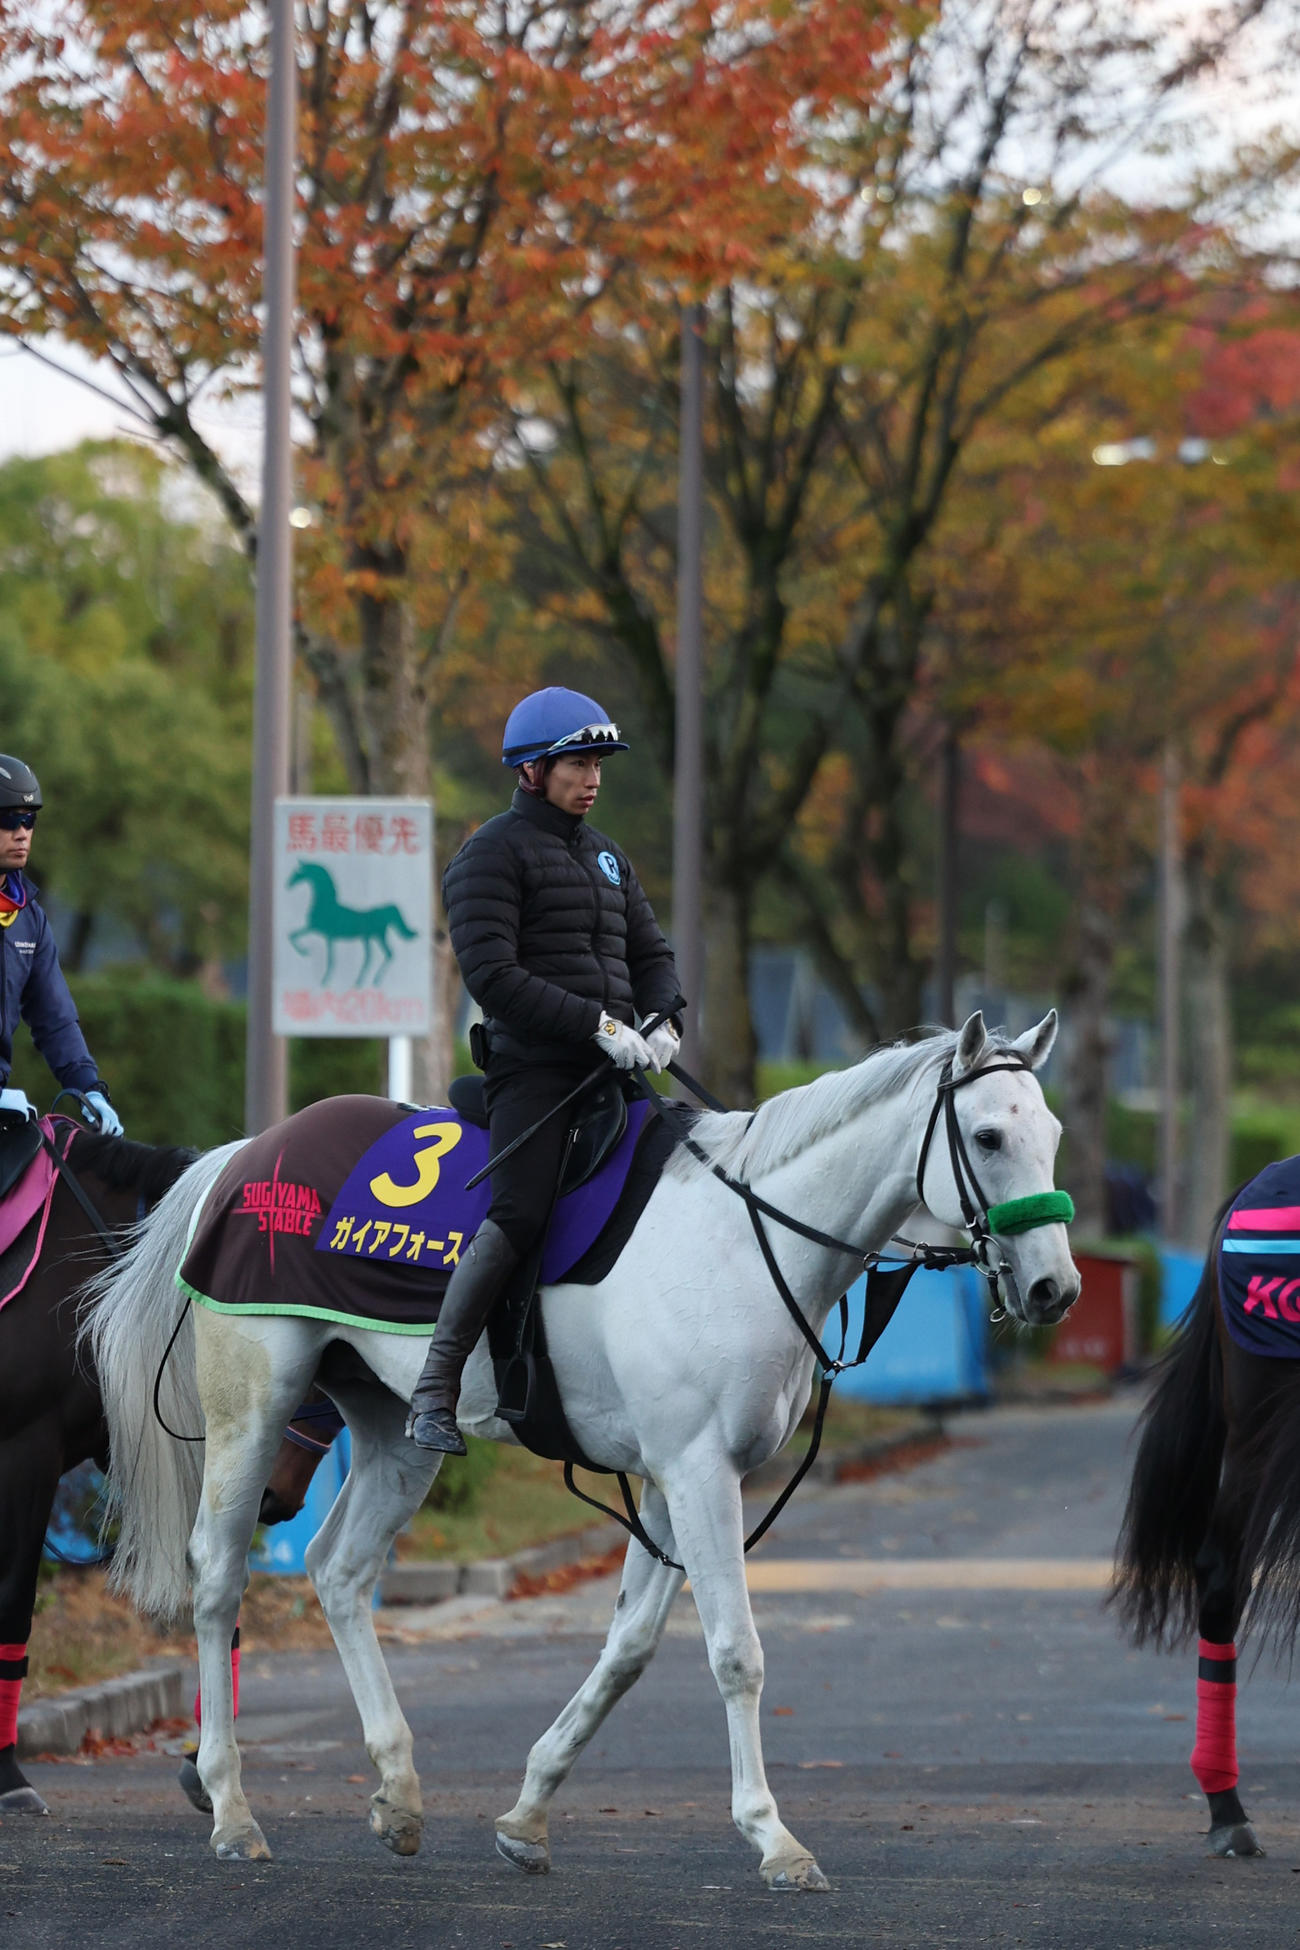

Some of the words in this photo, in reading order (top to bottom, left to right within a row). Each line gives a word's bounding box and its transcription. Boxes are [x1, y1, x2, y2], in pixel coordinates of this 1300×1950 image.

[370, 1122, 462, 1207] 3
[243, 1182, 321, 1213] SUGIYAMA
[258, 1208, 316, 1236] STABLE
[330, 1216, 463, 1266] ガイアフォース
